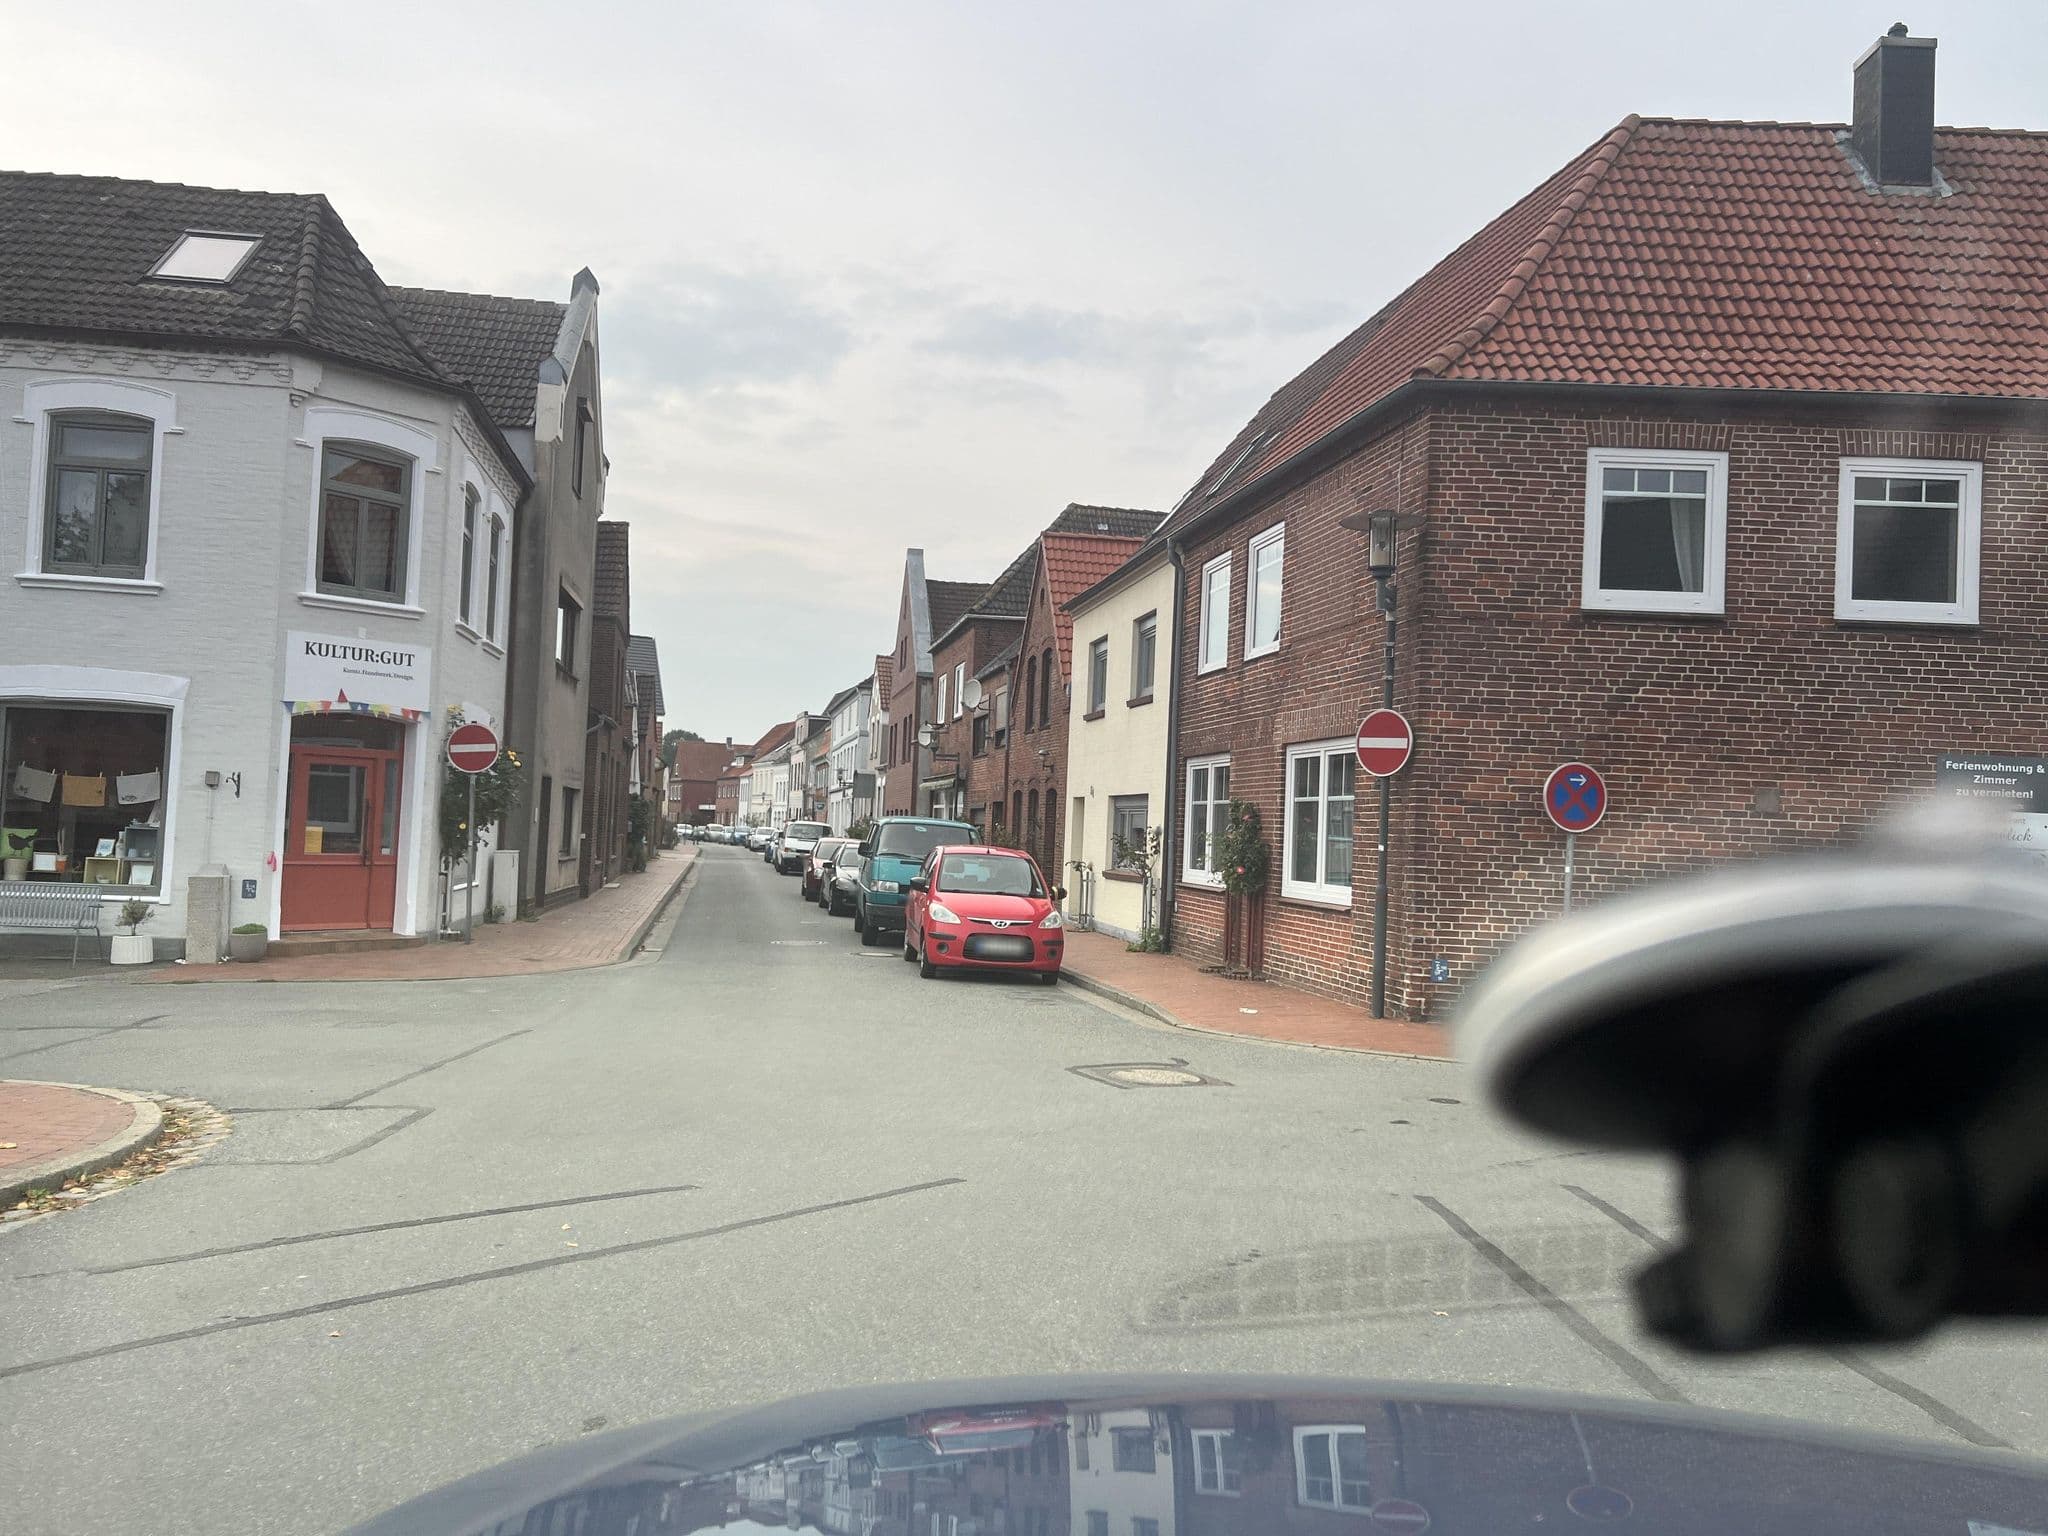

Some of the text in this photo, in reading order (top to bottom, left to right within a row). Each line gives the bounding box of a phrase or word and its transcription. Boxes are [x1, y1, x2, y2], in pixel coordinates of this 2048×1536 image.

[304, 641, 415, 667] KULTUR:GUT
[1945, 761, 2045, 774] Ferienwohnung &
[1973, 775, 2018, 785] Zimmer
[1956, 788, 2034, 799] zu vermieten!
